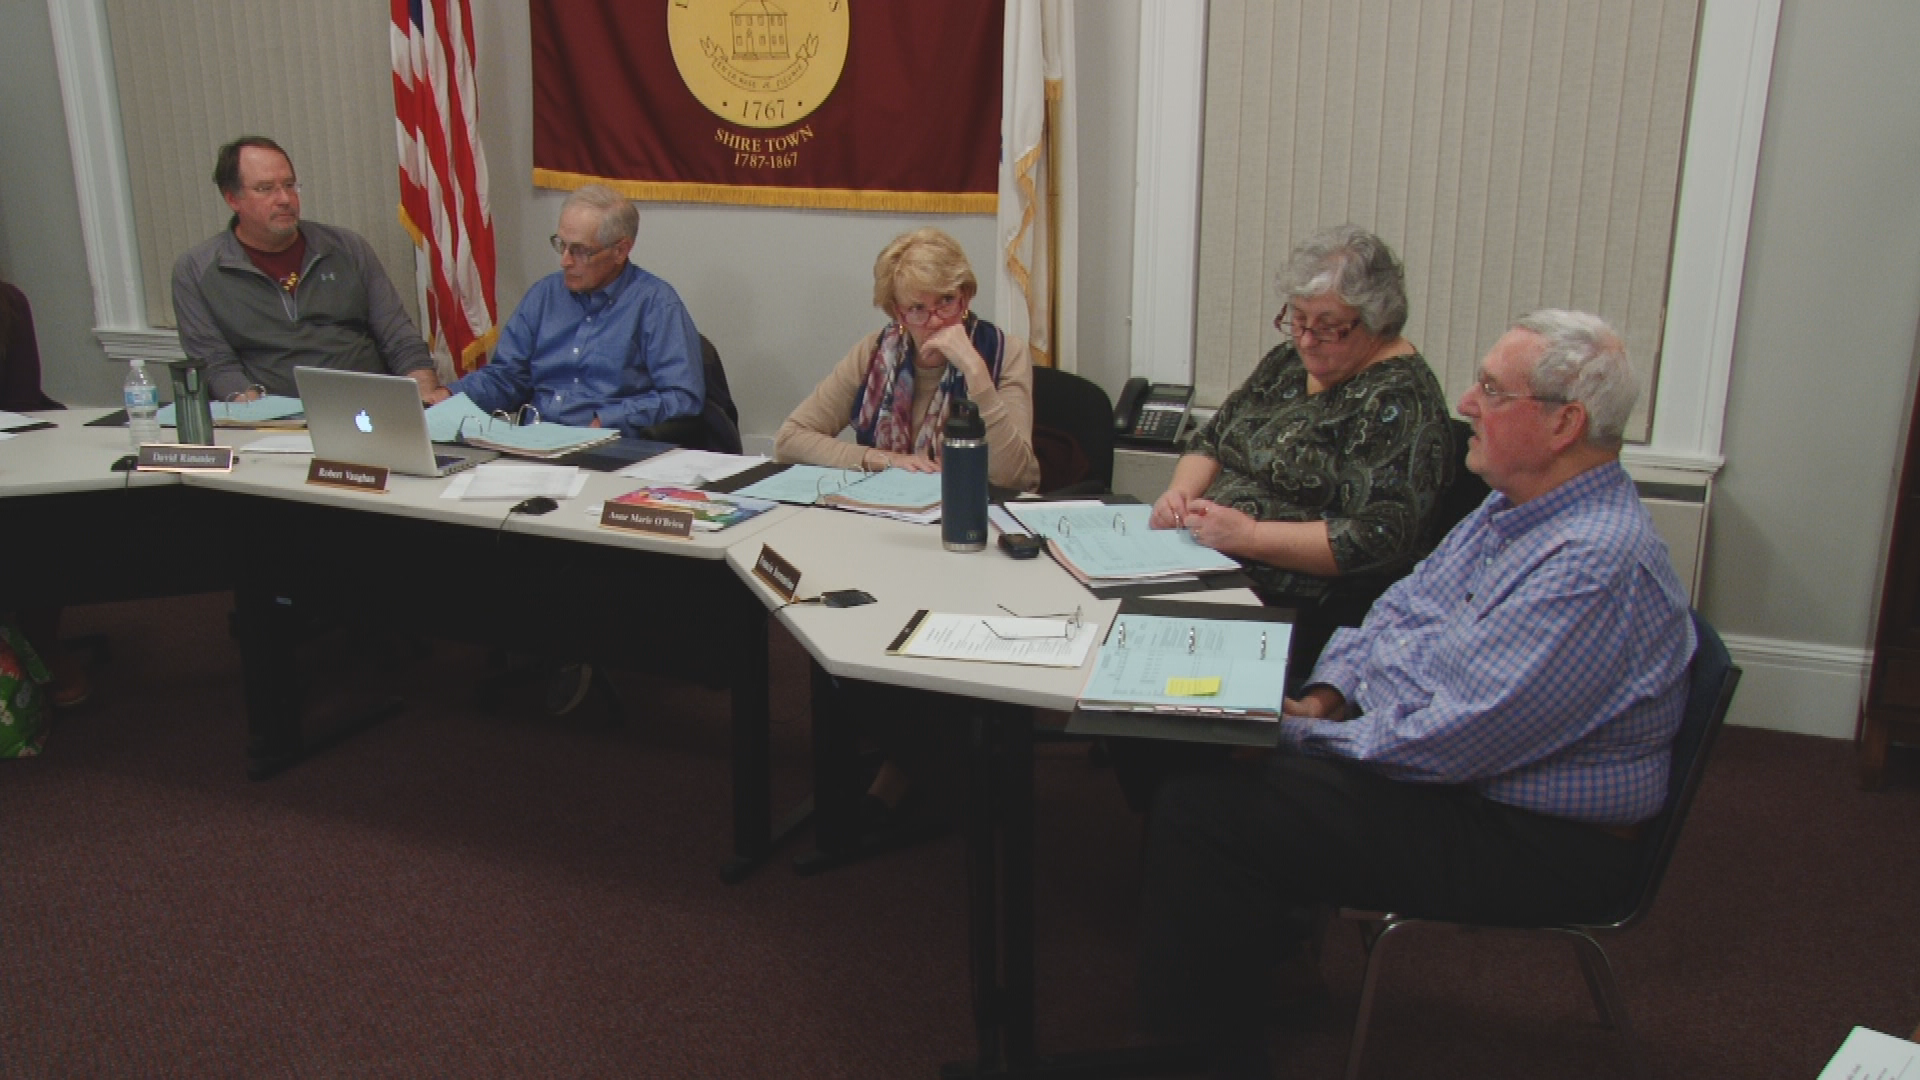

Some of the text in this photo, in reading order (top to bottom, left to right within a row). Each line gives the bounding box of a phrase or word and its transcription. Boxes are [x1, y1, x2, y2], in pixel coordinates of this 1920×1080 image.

[743, 99, 785, 120] 1767
[715, 124, 814, 152] SHIRE TOWN
[734, 152, 798, 168] 1787-1867
[152, 451, 178, 463] David
[318, 467, 376, 484] Robert Vaughan
[608, 511, 684, 529] Anne Marie O'Brien
